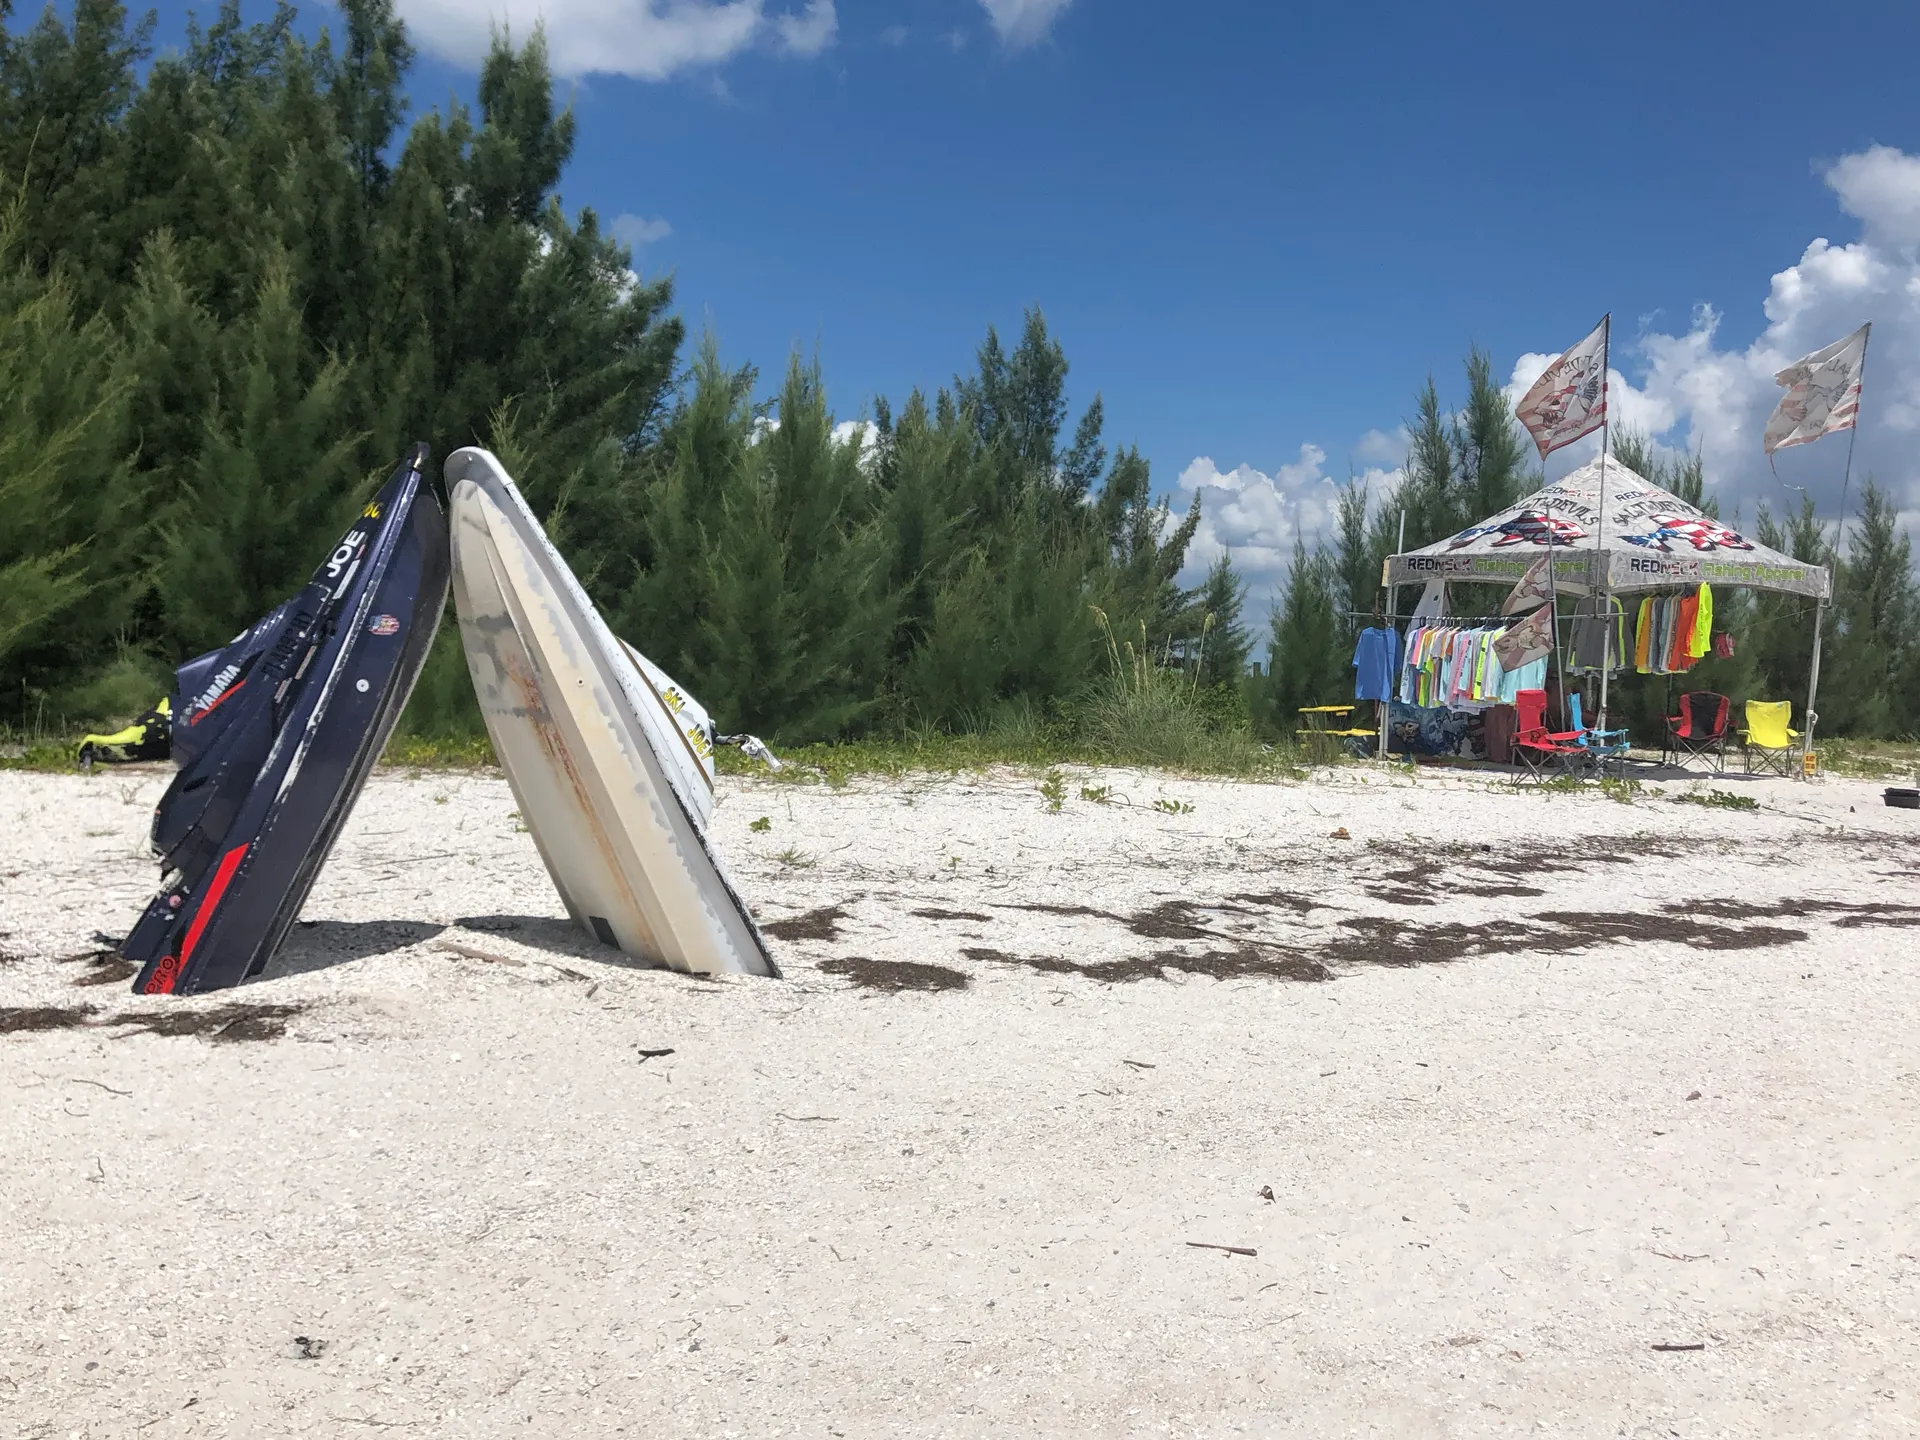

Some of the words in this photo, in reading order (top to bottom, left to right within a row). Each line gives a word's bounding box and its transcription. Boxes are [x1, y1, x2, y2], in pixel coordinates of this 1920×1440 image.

[326, 529, 367, 579] JOE
[1407, 557, 1472, 571] REDNECK
[1475, 558, 1527, 577] Fishing
[1630, 557, 1699, 576] REDNECK
[1702, 561, 1752, 581] Fishing
[1754, 563, 1806, 582] Apparel
[195, 663, 241, 711] YAMAHA
[664, 686, 685, 713] SKI
[688, 724, 713, 760] JOEY
[144, 956, 175, 995] PRO
